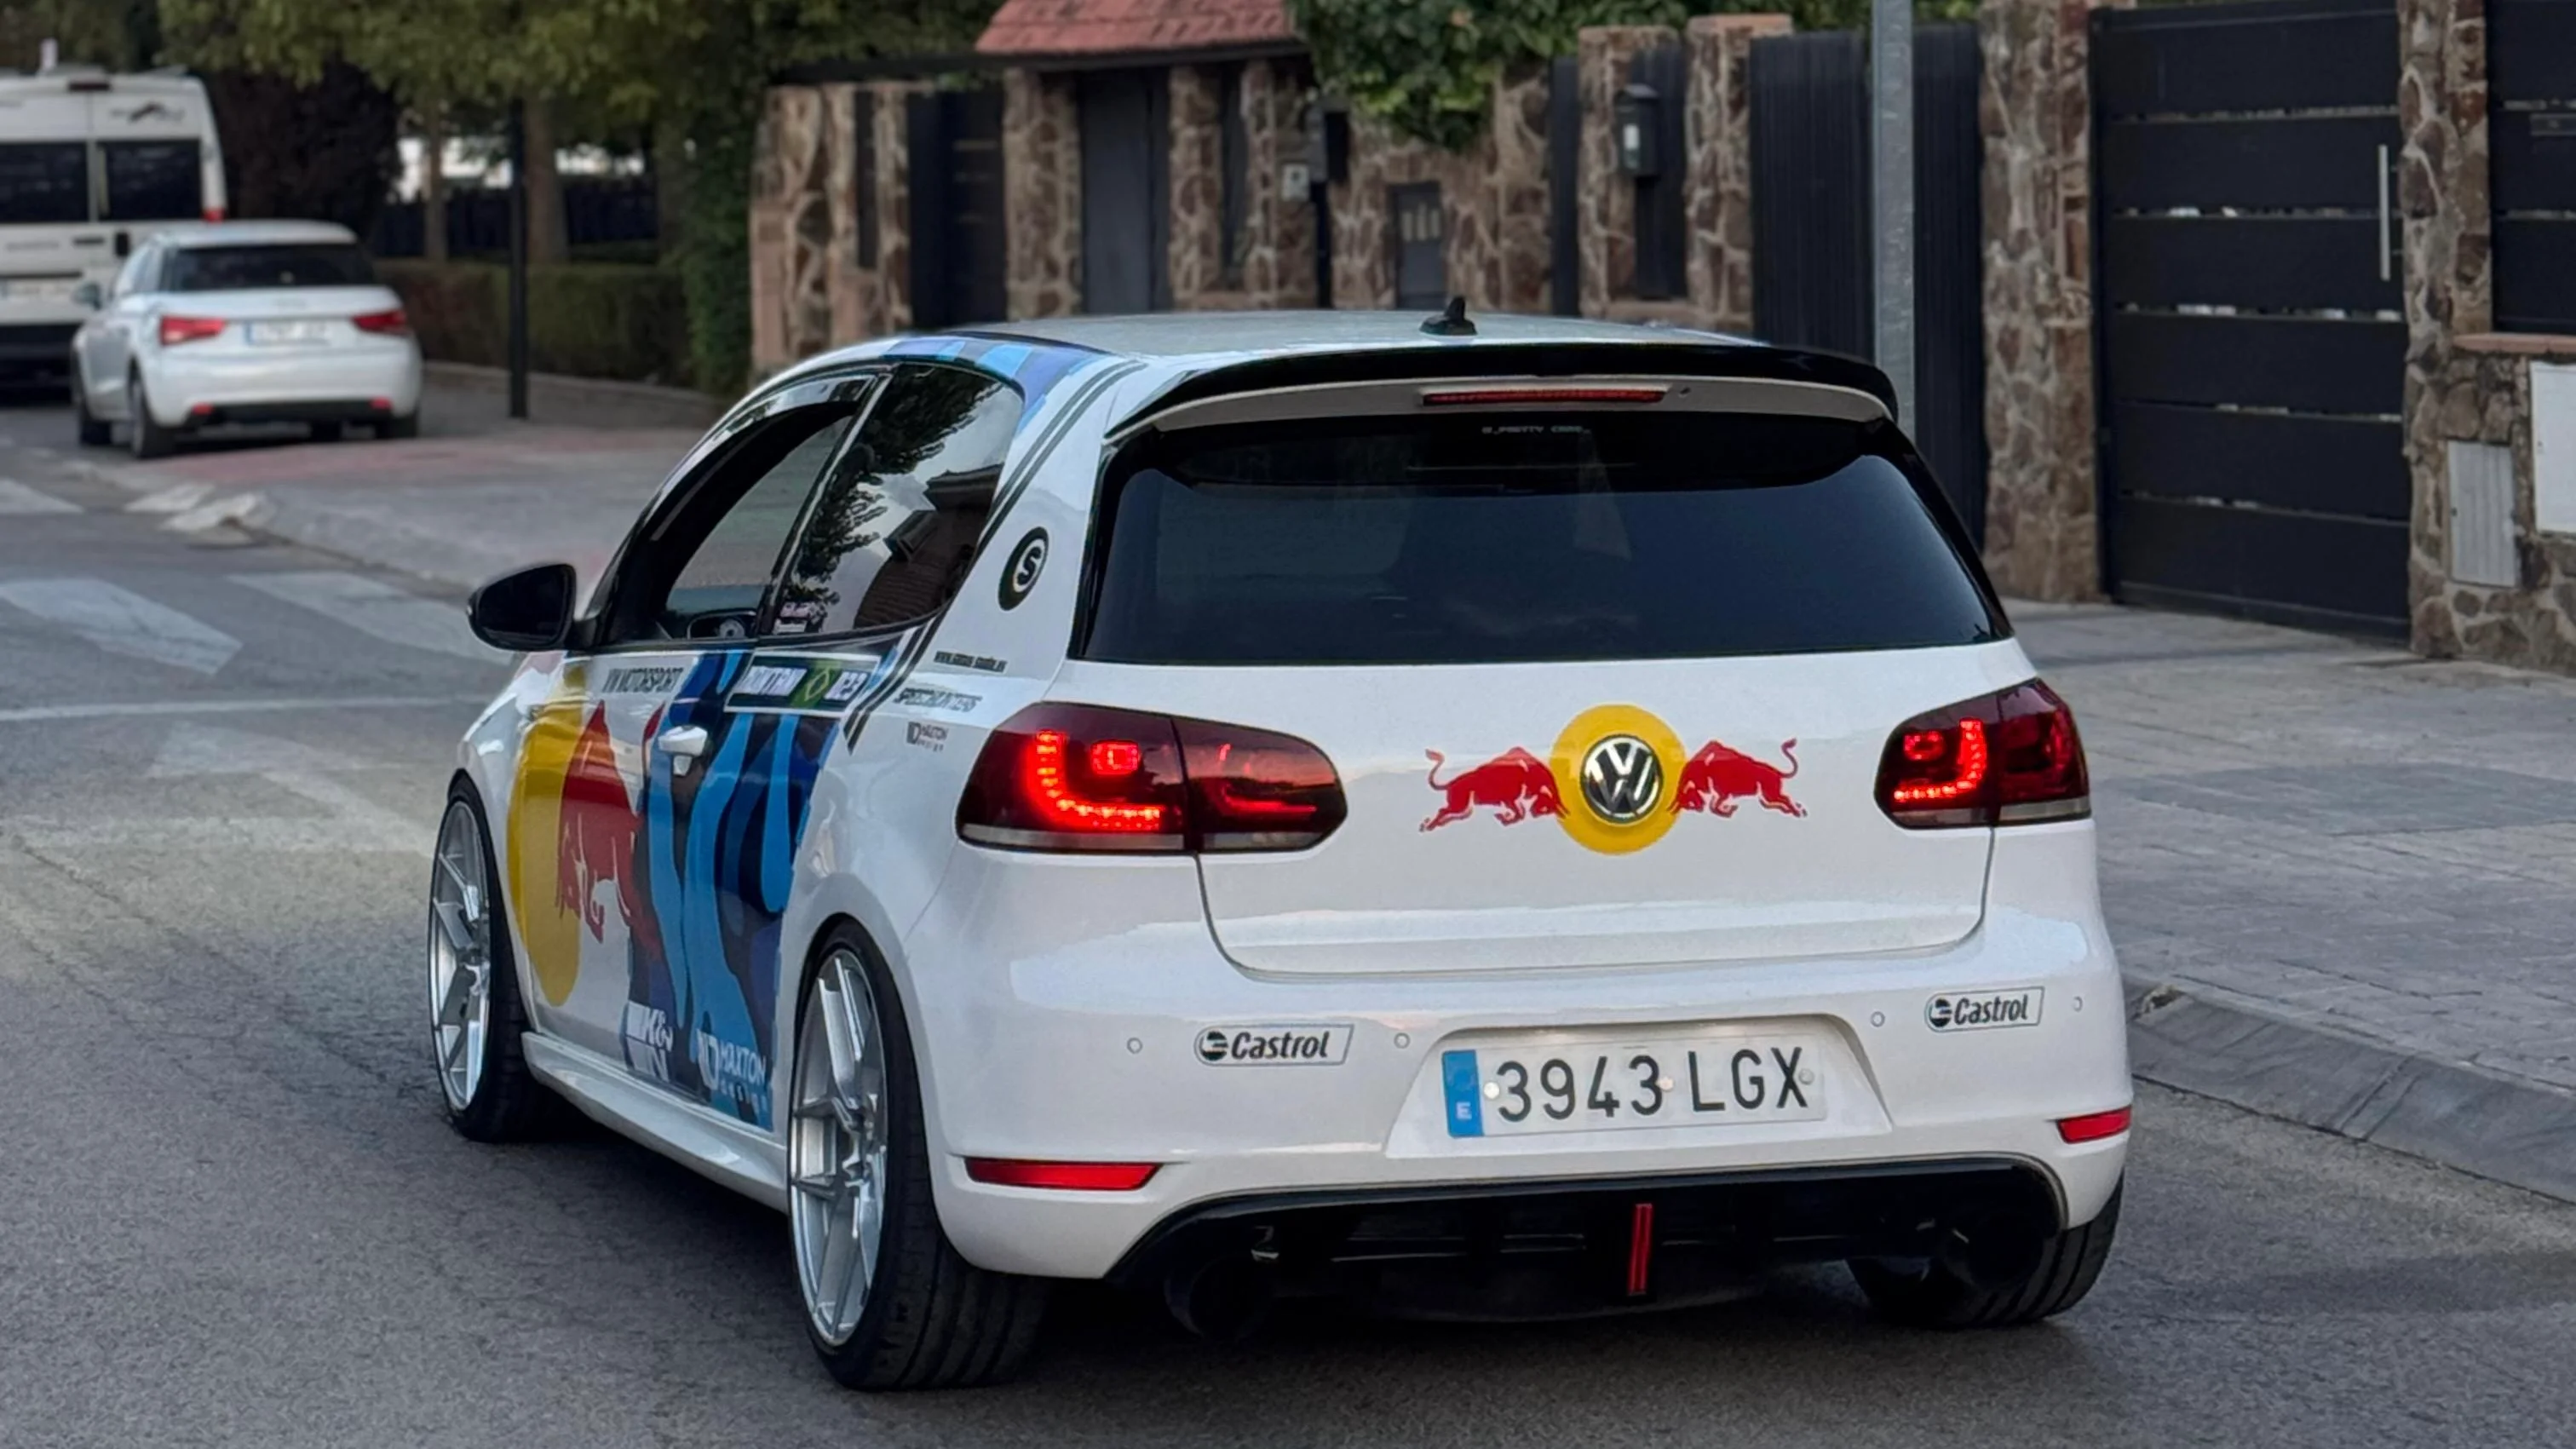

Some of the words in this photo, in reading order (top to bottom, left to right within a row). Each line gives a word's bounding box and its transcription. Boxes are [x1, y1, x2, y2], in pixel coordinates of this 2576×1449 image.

[1017, 546, 1042, 586] S
[1582, 735, 1662, 821] VW
[1954, 994, 2028, 1026] Castrol
[720, 1039, 767, 1085] MAXTON
[1231, 1031, 1330, 1060] Castrol
[1497, 1055, 1663, 1123] 3943
[1688, 1046, 1808, 1112] LGX
[1456, 1101, 1472, 1120] E
